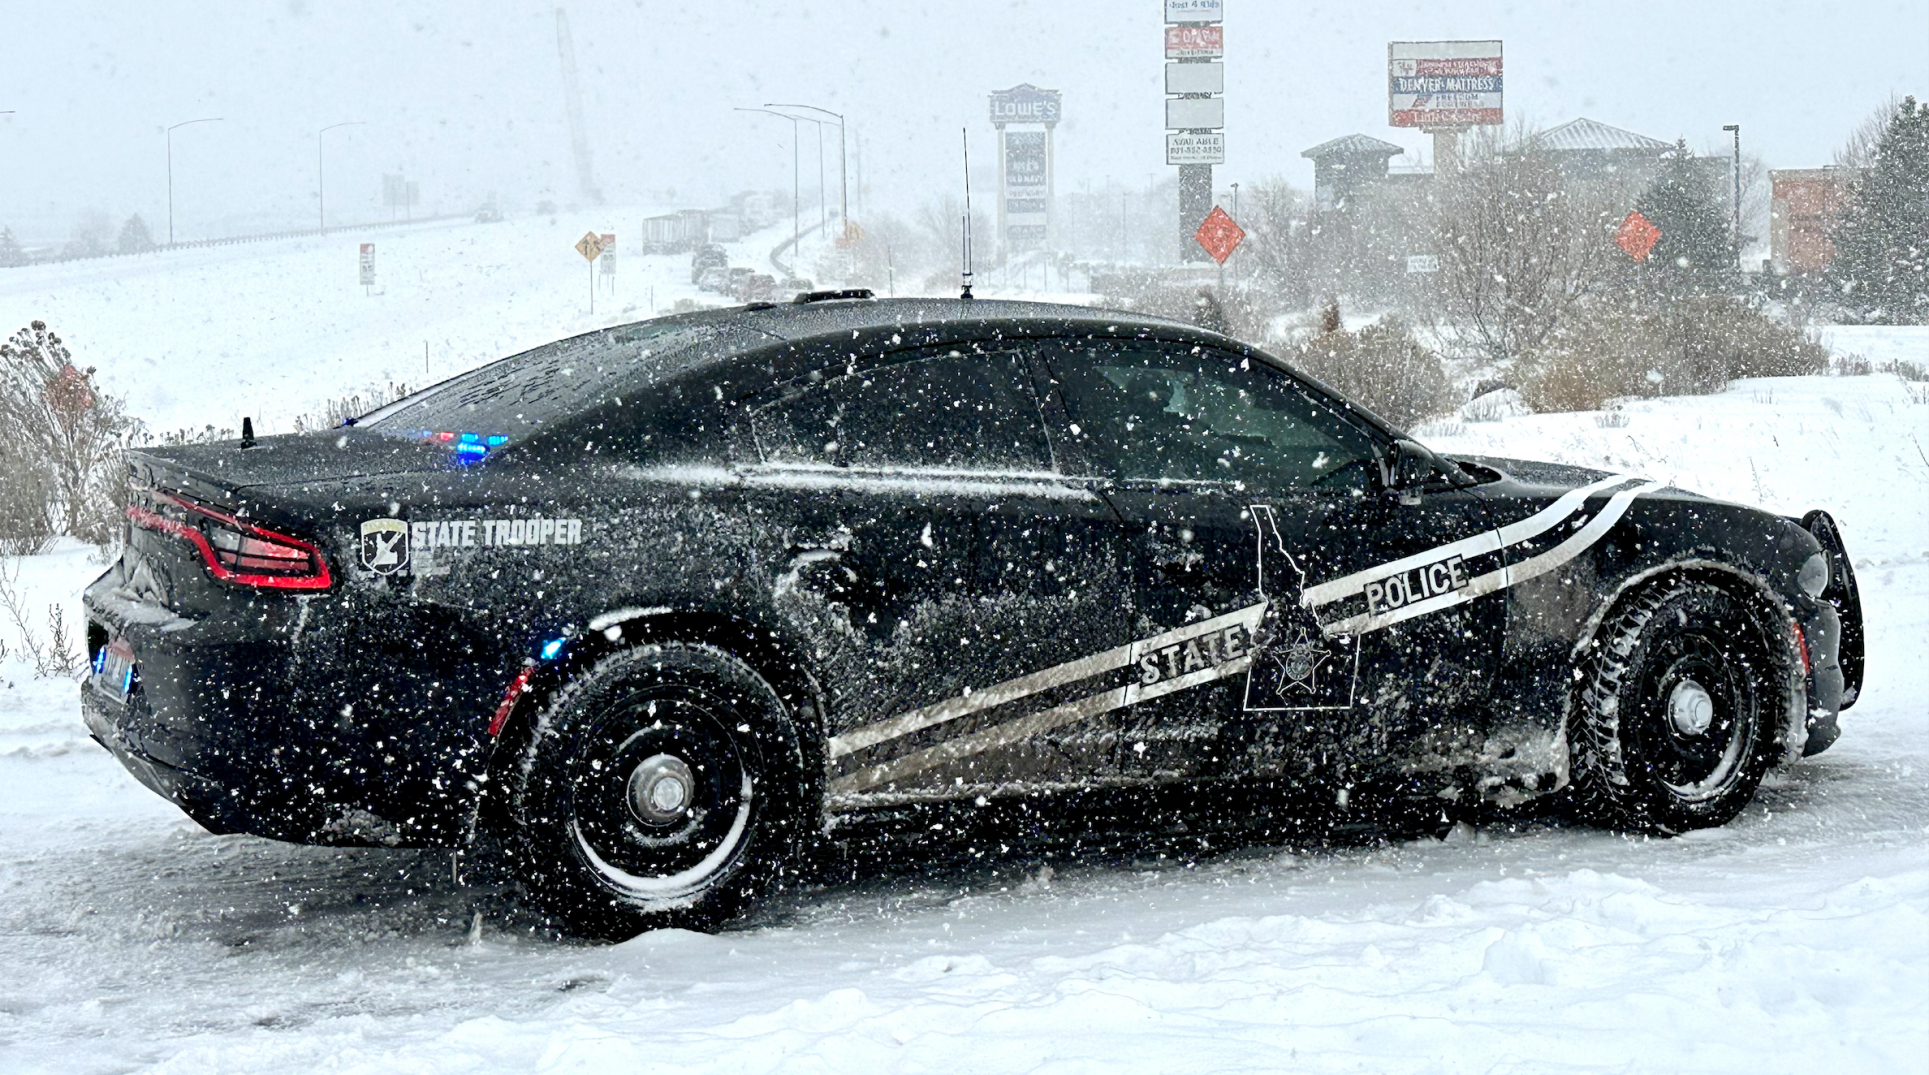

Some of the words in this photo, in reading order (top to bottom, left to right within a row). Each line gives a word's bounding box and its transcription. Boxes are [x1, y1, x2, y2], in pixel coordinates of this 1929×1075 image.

[1445, 76, 1494, 91] MATTRESS
[995, 101, 1056, 116] LOWE'S
[411, 521, 476, 548] STATE
[482, 518, 582, 545] TROOPER
[1366, 557, 1467, 616] POLICE
[1140, 625, 1244, 685] STATE
